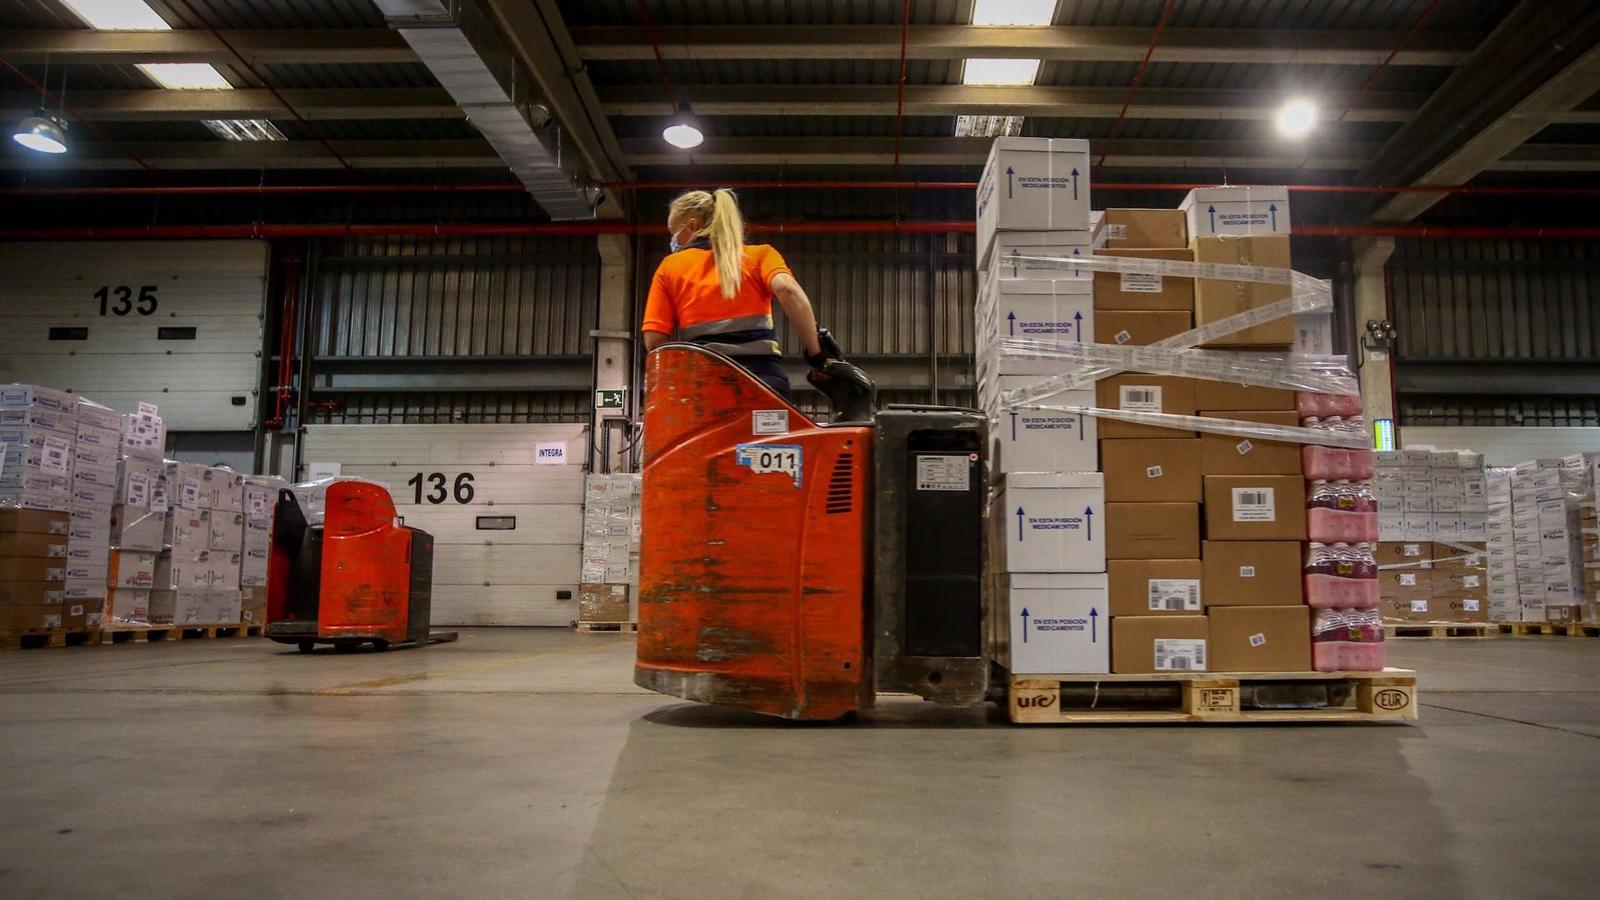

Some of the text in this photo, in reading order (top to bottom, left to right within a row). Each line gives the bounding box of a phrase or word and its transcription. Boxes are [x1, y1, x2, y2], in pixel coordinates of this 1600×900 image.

[94, 286, 158, 316] 135
[539, 448, 563, 457] INTEGRA
[760, 452, 795, 469] 011
[408, 472, 475, 505] 136
[1381, 692, 1402, 707] EUR
